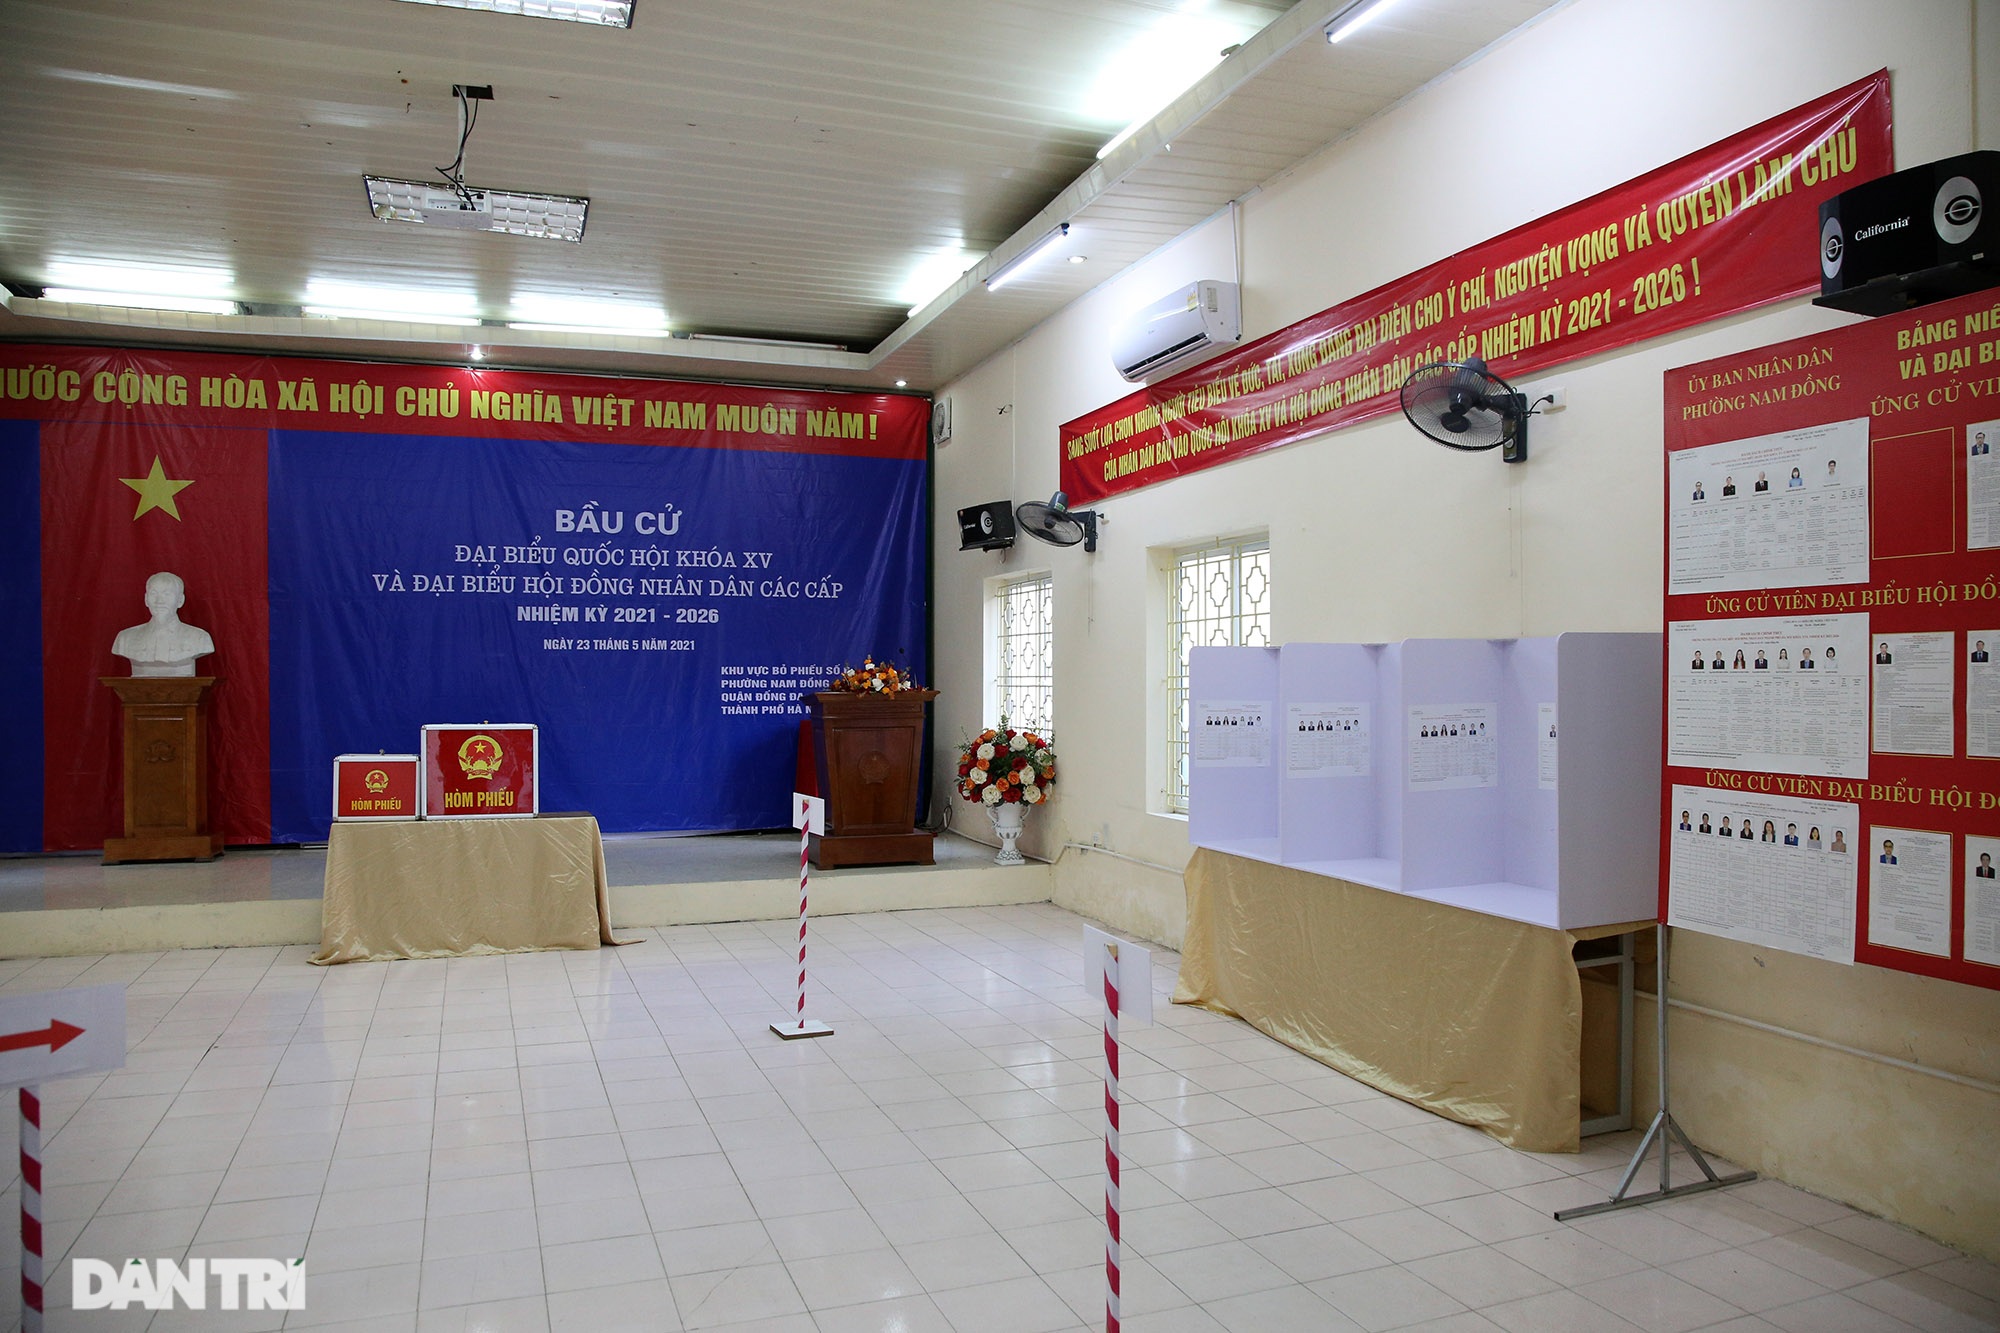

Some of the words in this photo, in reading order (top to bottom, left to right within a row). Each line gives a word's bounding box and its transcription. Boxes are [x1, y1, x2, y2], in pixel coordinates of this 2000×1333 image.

[1854, 217, 1909, 241] California
[1083, 422, 1100, 454] SUỐT
[1100, 422, 1114, 450] LỰA
[1114, 414, 1134, 443] CHỌN
[1187, 384, 1205, 415] TIÊU
[1207, 370, 1228, 408] BIỂU
[1228, 364, 1241, 400] VỀ
[1354, 317, 1377, 356] ĐẠI
[1379, 302, 1412, 345] DIỆN
[1414, 291, 1443, 331] CHO
[1446, 279, 1457, 318] Ý
[1460, 267, 1491, 314] CHÍ,
[1494, 243, 1563, 302] NGUYỆN
[1567, 222, 1620, 277] VỌNG
[1624, 203, 1653, 252] VÀ
[1656, 172, 1733, 244] QUYỀN
[1738, 153, 1793, 211] LÀM
[1800, 114, 1857, 187] CHỦ
[1897, 319, 1957, 351] BẢNG
[1103, 452, 1118, 482] CỦA
[1118, 447, 1138, 477] NHÂN
[1139, 441, 1155, 471] DÂN
[1156, 432, 1172, 465] BẦU
[1173, 430, 1189, 459] VÀO
[1190, 418, 1213, 456] QUỐC
[1215, 415, 1230, 450] HỘI
[1231, 407, 1257, 442] KHÓA
[1259, 404, 1272, 433] XV
[1274, 394, 1288, 428] VÀ
[1290, 388, 1309, 426] HỘI
[1310, 376, 1342, 417] ĐỒNG
[1345, 364, 1380, 405] NHÂN
[1382, 353, 1411, 394] DÂN
[1414, 342, 1443, 386] CÁC
[1447, 324, 1478, 373] CẤP
[1481, 312, 1535, 362] NHIỆM
[1540, 298, 1562, 345] KỲ
[1567, 288, 1613, 335] 2021
[1617, 297, 1627, 308] -
[1632, 263, 1687, 316] 2026
[1691, 257, 1701, 297] !
[1687, 374, 1709, 394] ỦY
[1712, 368, 1744, 389] BAN
[1747, 356, 1794, 381] NHÂN
[1796, 346, 1834, 370] DÂN
[1899, 353, 1927, 380] VÀ
[1933, 346, 1971, 374] ĐẠI
[0, 364, 81, 402] ƯỚC
[93, 368, 188, 410] CỘNG
[200, 372, 268, 410] HÒA
[277, 377, 320, 412] XÃ
[330, 379, 384, 420] HỘI
[395, 382, 459, 419] CHỦ
[470, 389, 562, 424] NGHĨA
[572, 393, 635, 432] VIỆT
[644, 400, 707, 431] NAM
[716, 402, 797, 436] MUÔN
[1682, 394, 1745, 421] PHƯỜNG
[1749, 386, 1787, 408] NAM
[1790, 372, 1841, 397] ĐỒNG
[1870, 393, 1920, 417] ỨNG
[1927, 379, 1962, 406] CỬ
[1967, 377, 2000, 398] VI
[555, 501, 624, 535] BẦU
[635, 503, 684, 536] CỬ
[455, 544, 498, 569] ĐẠI
[503, 535, 557, 566] BIỂU
[563, 540, 625, 570] QUỐC
[630, 544, 671, 572] HỘI
[676, 546, 738, 569] KHÓA
[743, 552, 774, 570] XV
[372, 570, 404, 593] VÀ
[412, 574, 456, 599] ĐẠI
[461, 563, 516, 594] BIỂU
[522, 571, 565, 600] HỘI
[570, 569, 635, 596] ĐỒNG
[639, 574, 703, 597] NHÂN
[708, 574, 755, 598] DÂN
[759, 575, 800, 599] CÁC
[804, 573, 844, 600] CẤP
[1705, 595, 1741, 614] ỨNG
[1745, 590, 1770, 612] CỬ
[1773, 589, 1818, 611] VIÊN
[1821, 591, 1858, 612] ĐẠI
[1860, 579, 1911, 607] BIỂU
[1917, 580, 1958, 607] HỘI
[1963, 573, 2000, 600] ĐỒ
[516, 603, 580, 627] NHIỆM
[584, 603, 609, 623] KỲ
[613, 607, 657, 624] 2021
[675, 608, 720, 625] 2026
[543, 636, 575, 652] NGÀY
[576, 639, 591, 652] 23
[593, 636, 630, 653] THÁNG
[631, 640, 639, 653] 5
[641, 637, 671, 653] NĂM
[672, 640, 696, 653] 2021
[721, 666, 745, 676] KHU
[747, 665, 770, 677] VỰC
[772, 663, 787, 676] BỎ
[790, 663, 823, 676] PHIẾU
[825, 663, 841, 676] SỐ
[721, 678, 768, 689] PHƯỜNG
[770, 679, 797, 688] NAM
[721, 691, 752, 705] QUẬN
[721, 704, 759, 716] THÀNH
[761, 702, 785, 715] PHỐ
[787, 703, 803, 715] HÀ
[351, 797, 372, 811] HÒM
[374, 796, 402, 811] PHIẾU
[444, 788, 474, 808] HÒM
[477, 786, 514, 807] PHIẾU
[1705, 768, 1742, 789] ỨNG
[1776, 774, 1823, 796] VIÊN
[1827, 781, 1864, 803] ĐẠI
[1869, 777, 1923, 805] BIỂU
[1929, 785, 1973, 812] HỘI
